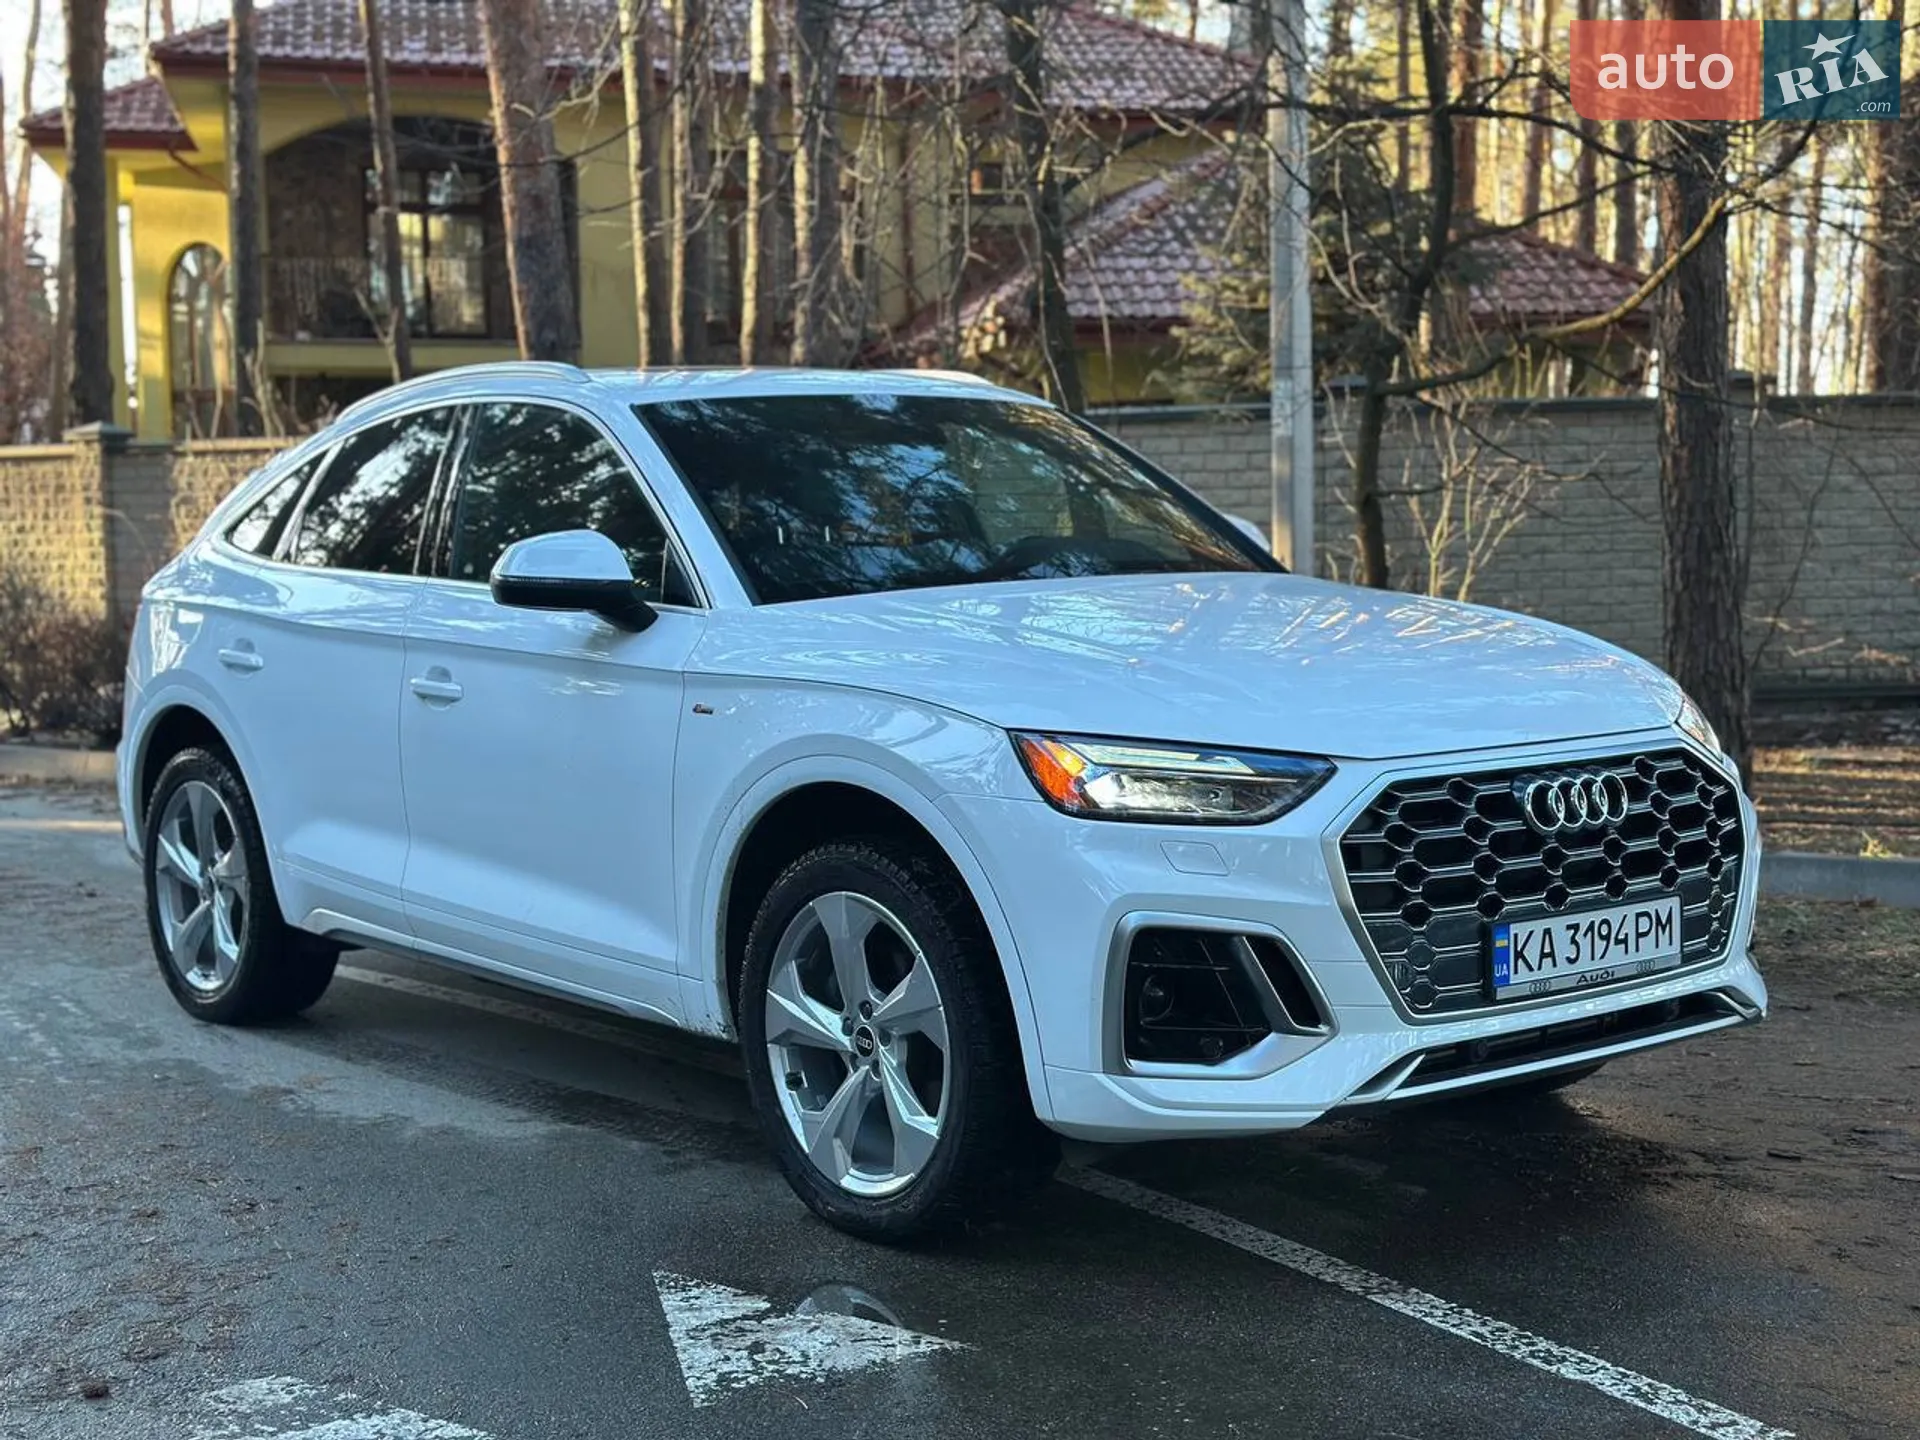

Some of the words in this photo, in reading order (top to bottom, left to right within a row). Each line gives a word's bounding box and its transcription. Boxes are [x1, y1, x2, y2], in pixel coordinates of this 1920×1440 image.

[1513, 927, 1557, 975] KA
[1564, 914, 1628, 965] 3194
[1635, 906, 1673, 952] PM
[1494, 963, 1509, 977] UA
[1576, 970, 1616, 985] Audi
